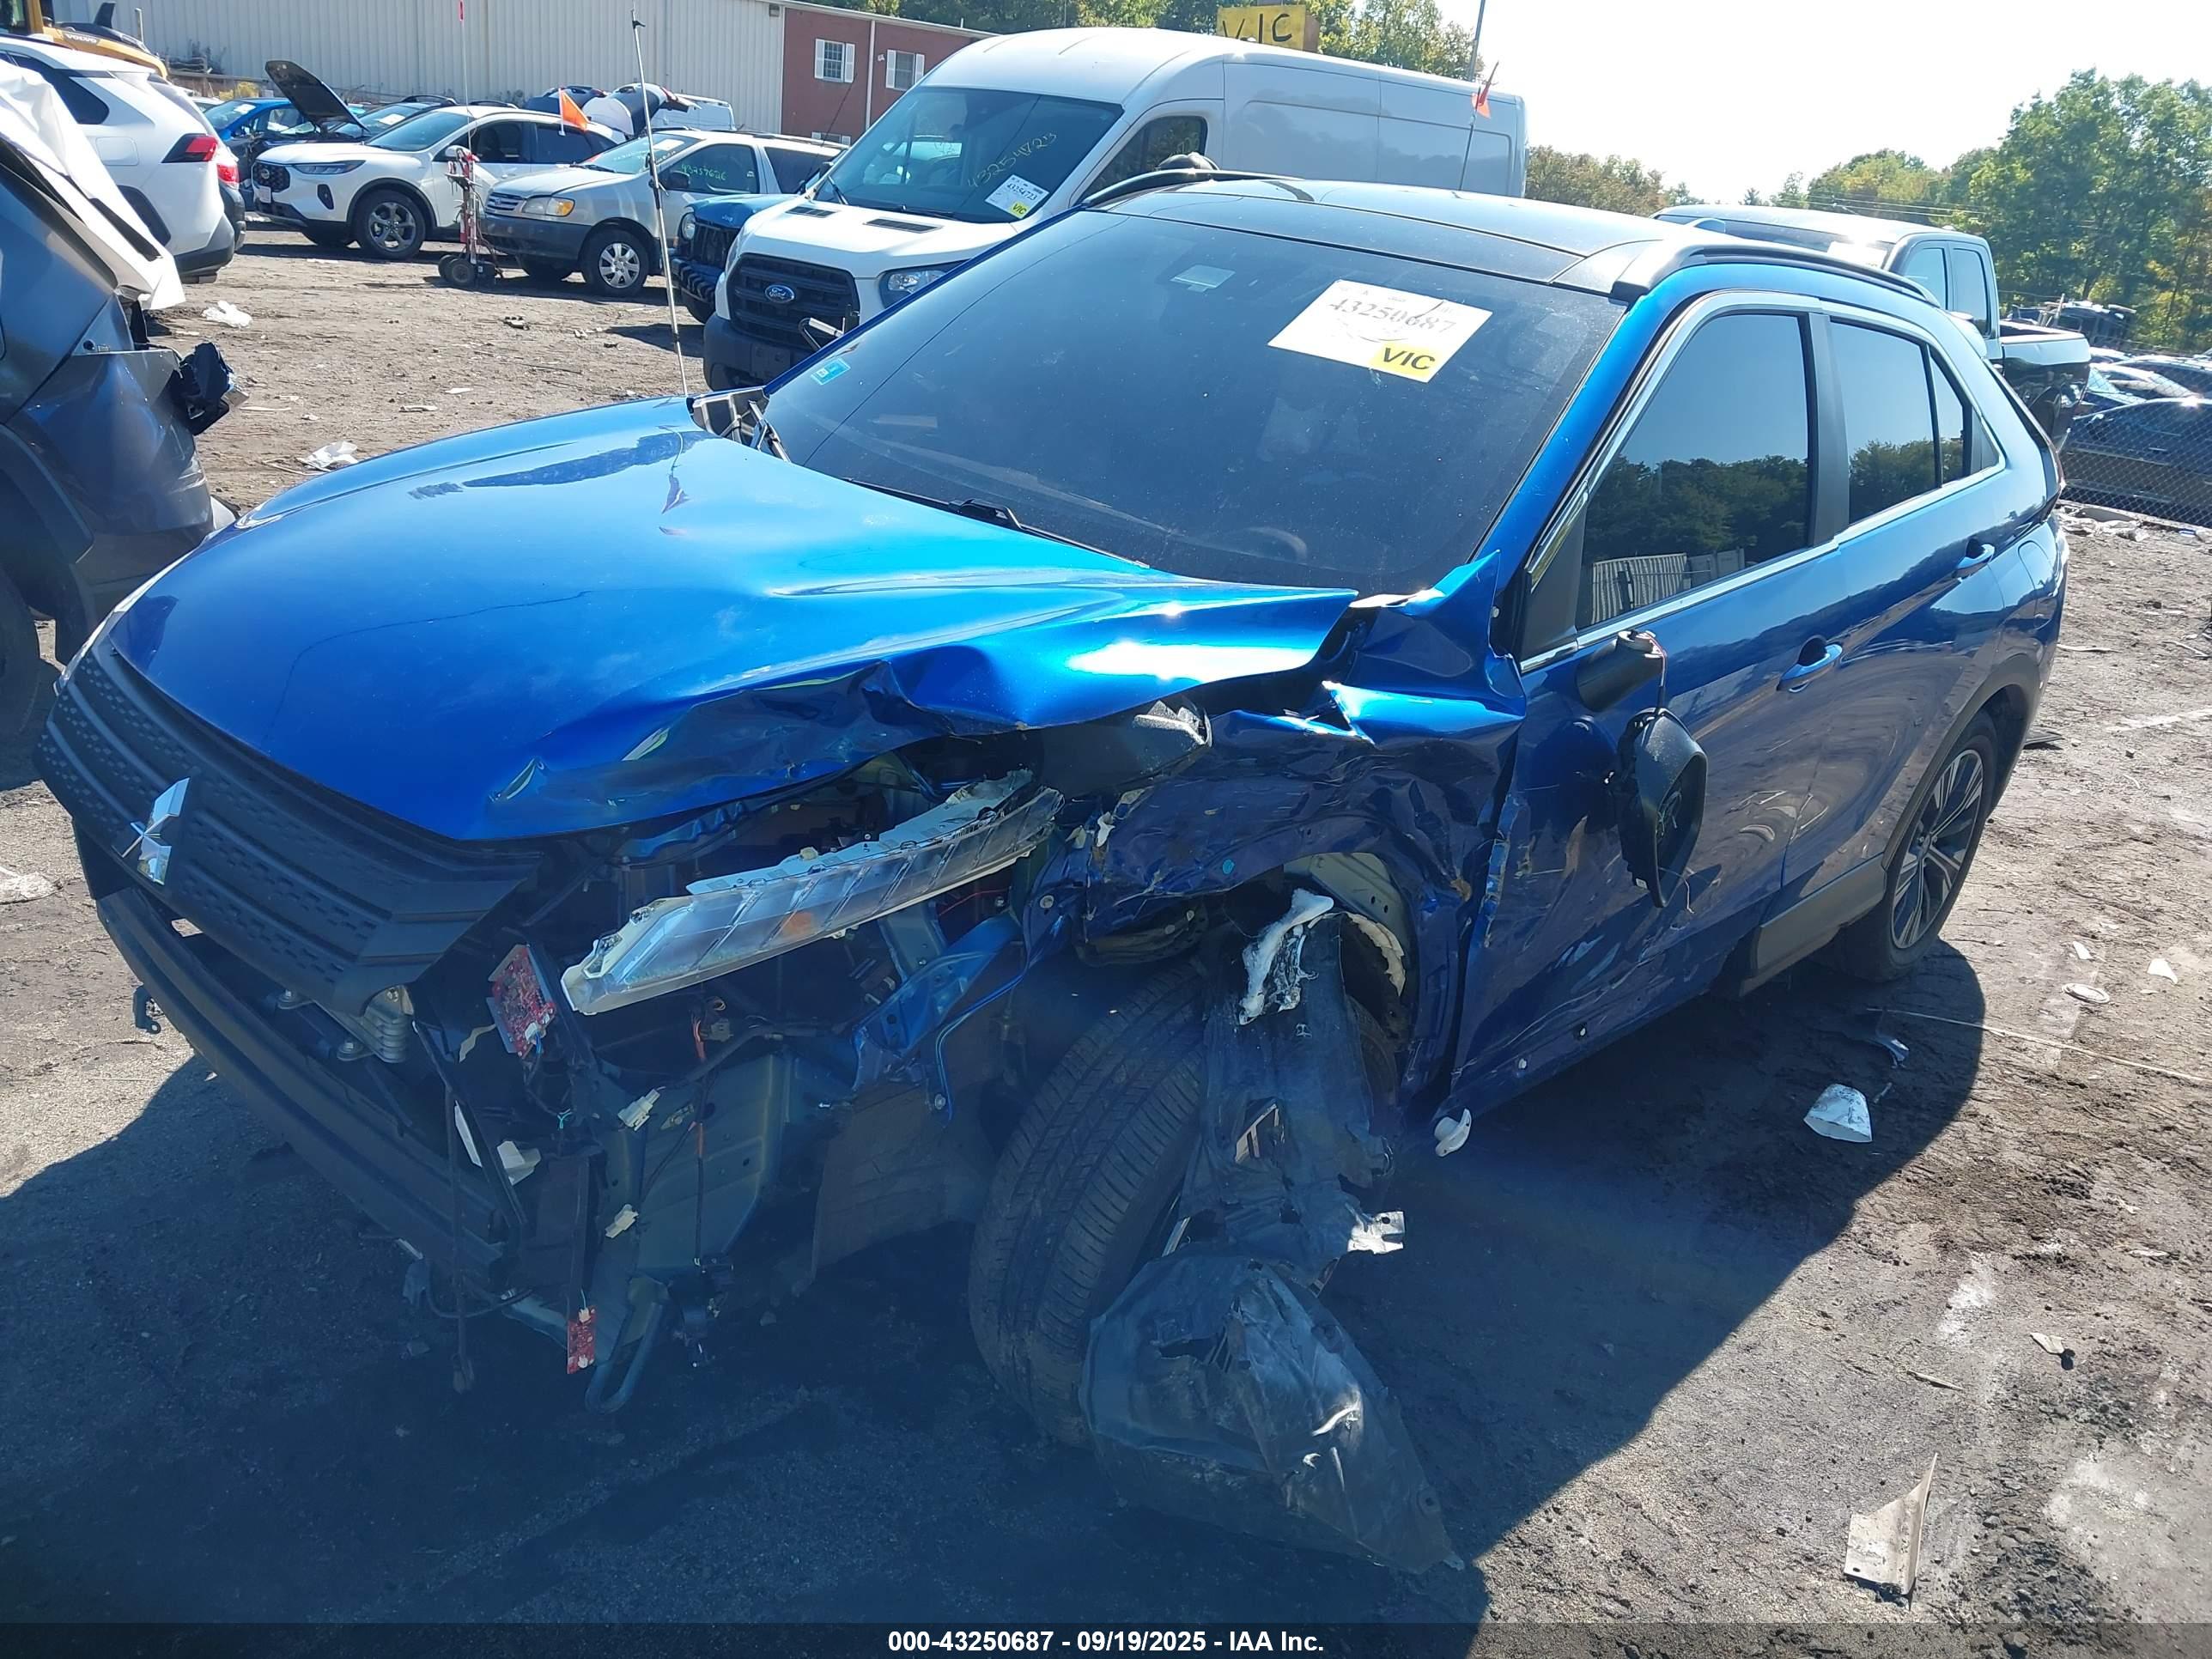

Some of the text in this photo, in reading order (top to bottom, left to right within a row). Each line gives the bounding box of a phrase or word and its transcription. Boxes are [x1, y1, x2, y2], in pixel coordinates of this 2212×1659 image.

[1222, 13, 1292, 44] VIC
[1013, 203, 1028, 216] VIC
[1328, 297, 1457, 334] 43250687
[1382, 347, 1436, 371] VIC
